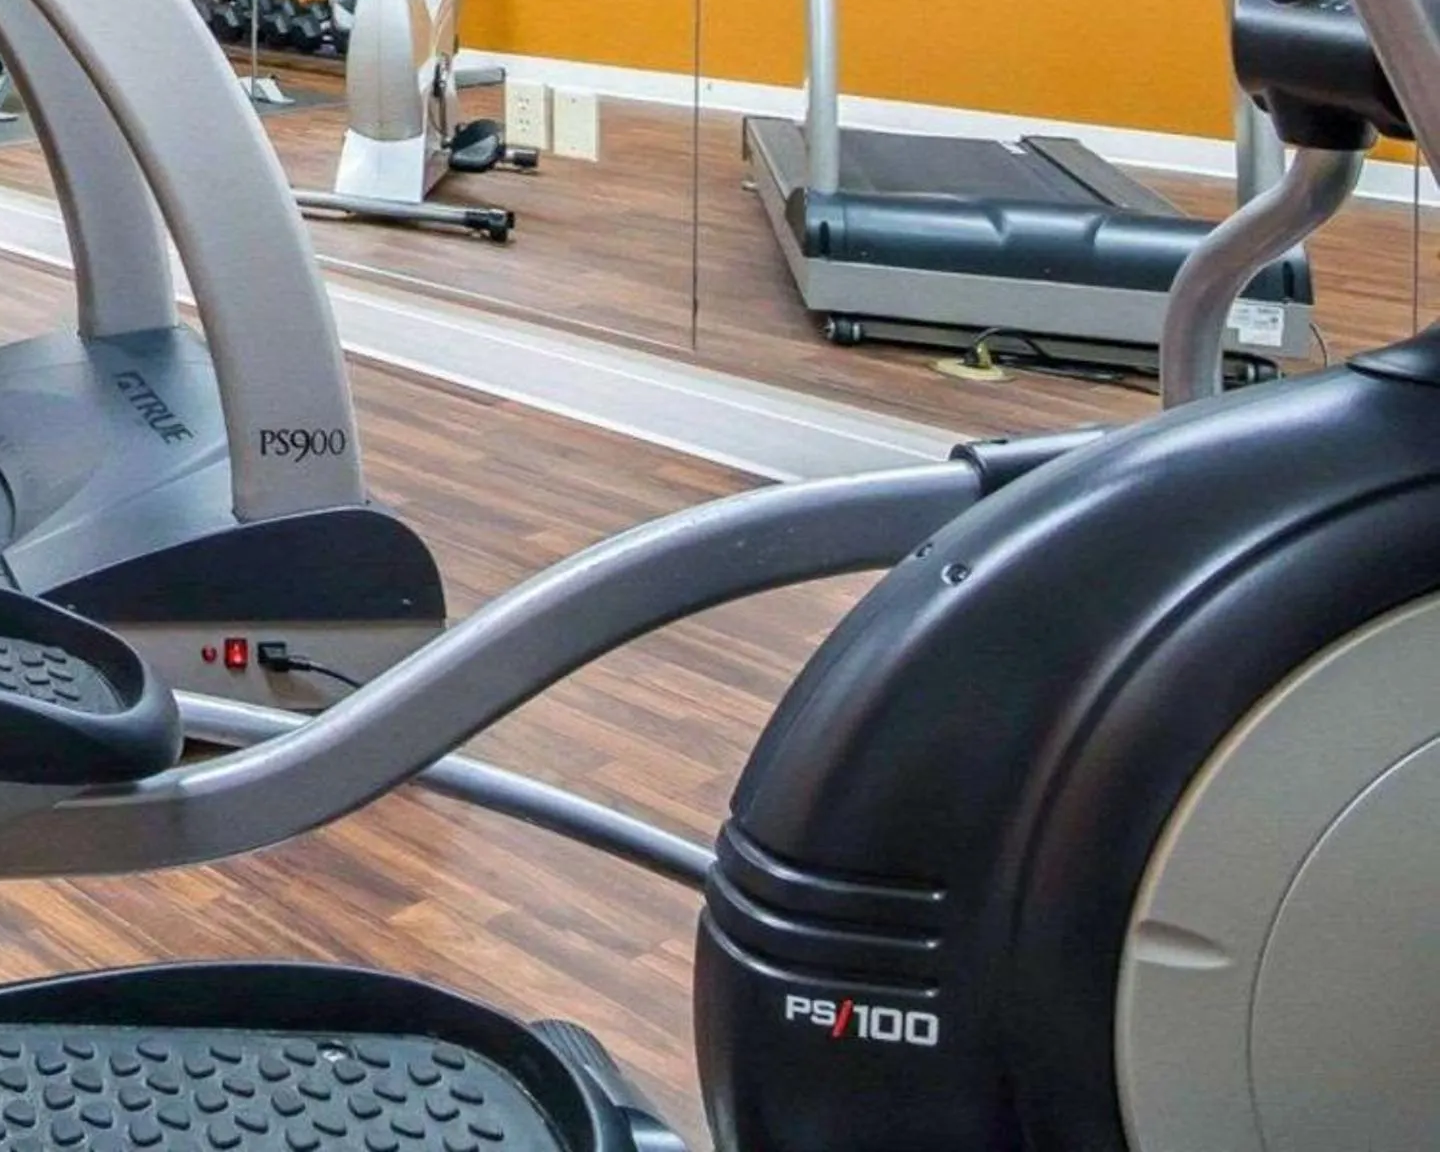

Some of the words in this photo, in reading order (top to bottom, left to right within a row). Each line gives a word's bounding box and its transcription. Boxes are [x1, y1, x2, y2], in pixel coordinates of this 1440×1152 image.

[127, 385, 194, 445] TRUE
[260, 428, 346, 462] PS900
[785, 994, 940, 1046] PS/100
